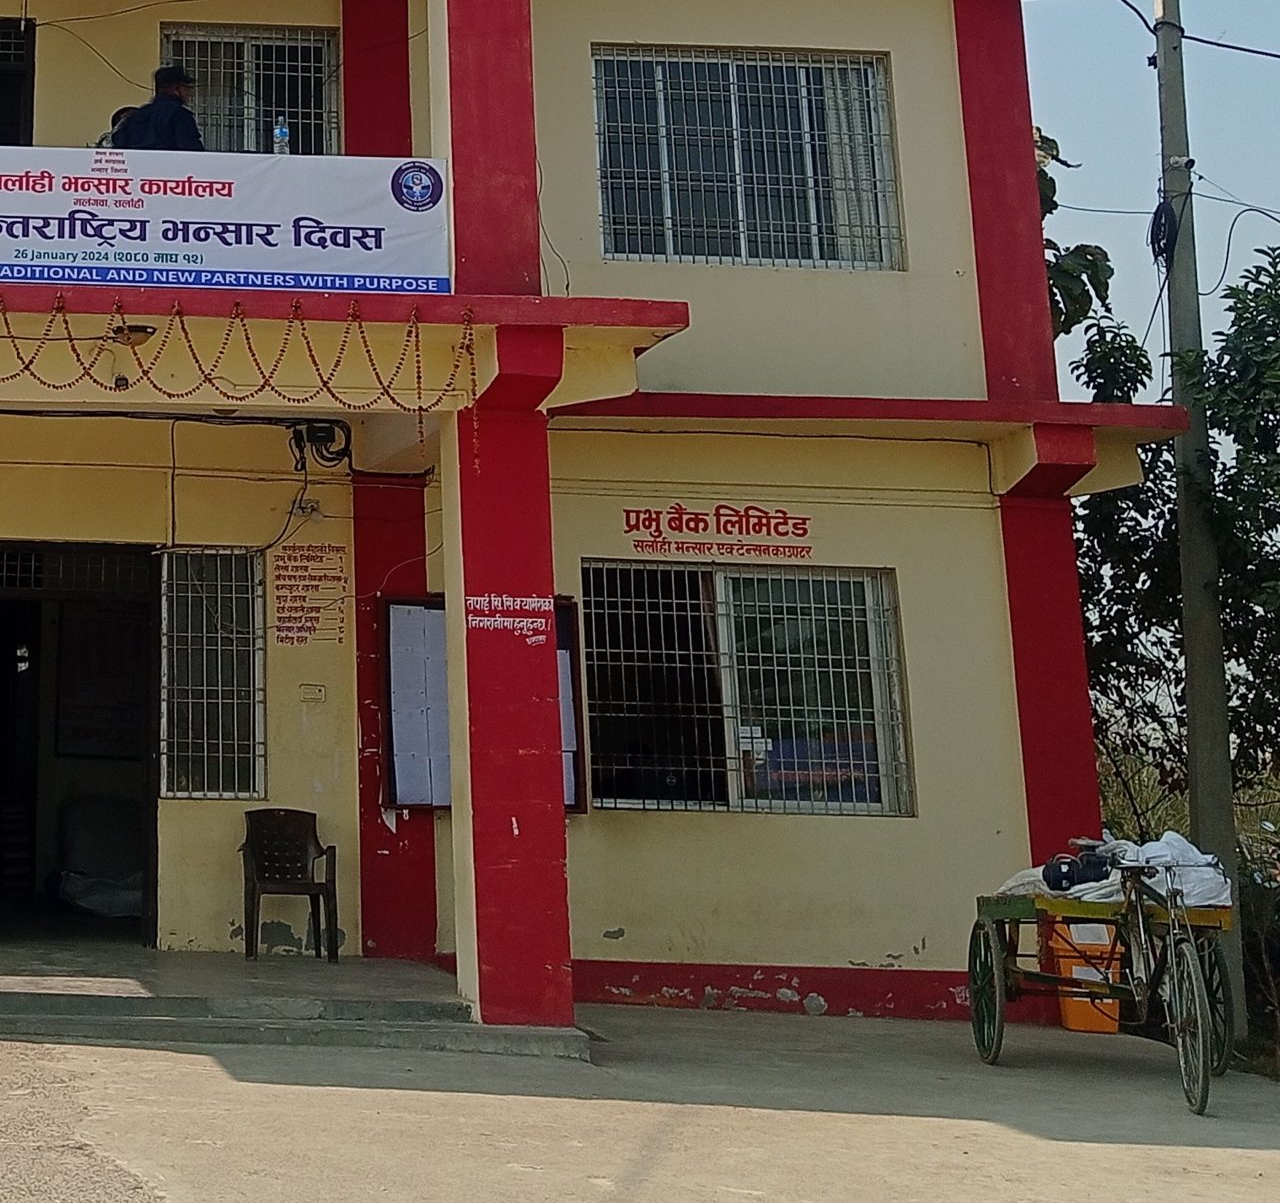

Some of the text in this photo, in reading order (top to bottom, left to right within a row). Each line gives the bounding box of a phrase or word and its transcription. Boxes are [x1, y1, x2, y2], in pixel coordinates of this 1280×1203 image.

[61, 175, 134, 195] भन्सार
[140, 176, 235, 198] कार्यालय
[161, 220, 282, 246] भन्सार
[292, 216, 386, 251] दिवस
[14, 249, 204, 265] 26 January 2024 (२०८० माघ १२)
[106, 269, 147, 282] AND
[153, 270, 195, 283] NEW
[201, 272, 295, 286] PARTNERS
[300, 275, 348, 288] WITH
[354, 277, 438, 291] PURPOSE
[623, 503, 811, 538] प्रभु बैंक लिमिटेड
[633, 538, 672, 557] सर्लाही
[674, 542, 713, 556] भन्सार
